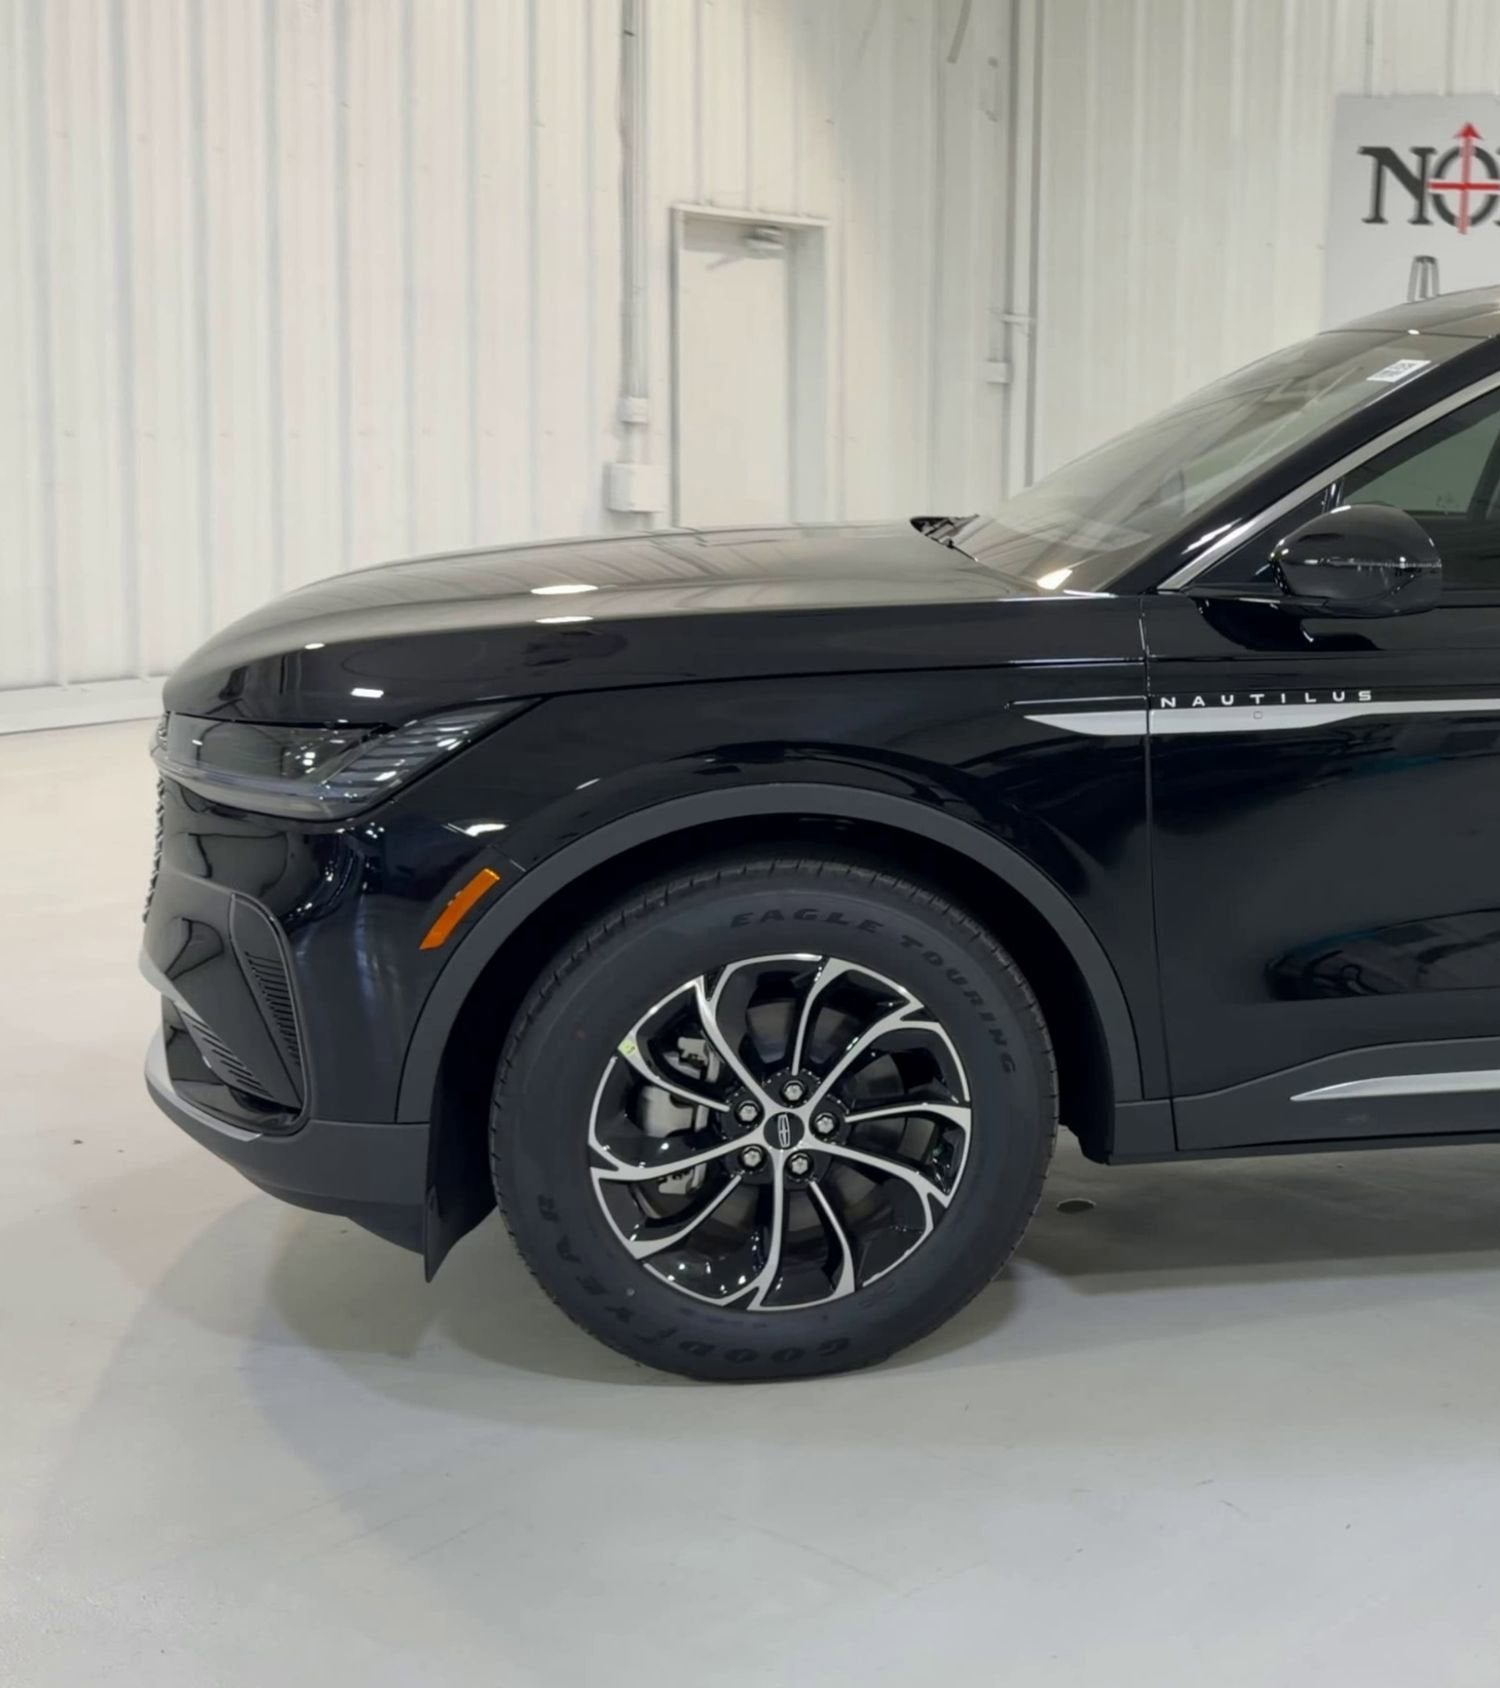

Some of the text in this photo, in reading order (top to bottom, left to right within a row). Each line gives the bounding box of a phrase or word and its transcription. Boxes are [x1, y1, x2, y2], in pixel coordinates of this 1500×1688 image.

[1160, 690, 1372, 708] NAUTILUS
[730, 907, 1017, 1074] EAGLE TOURING
